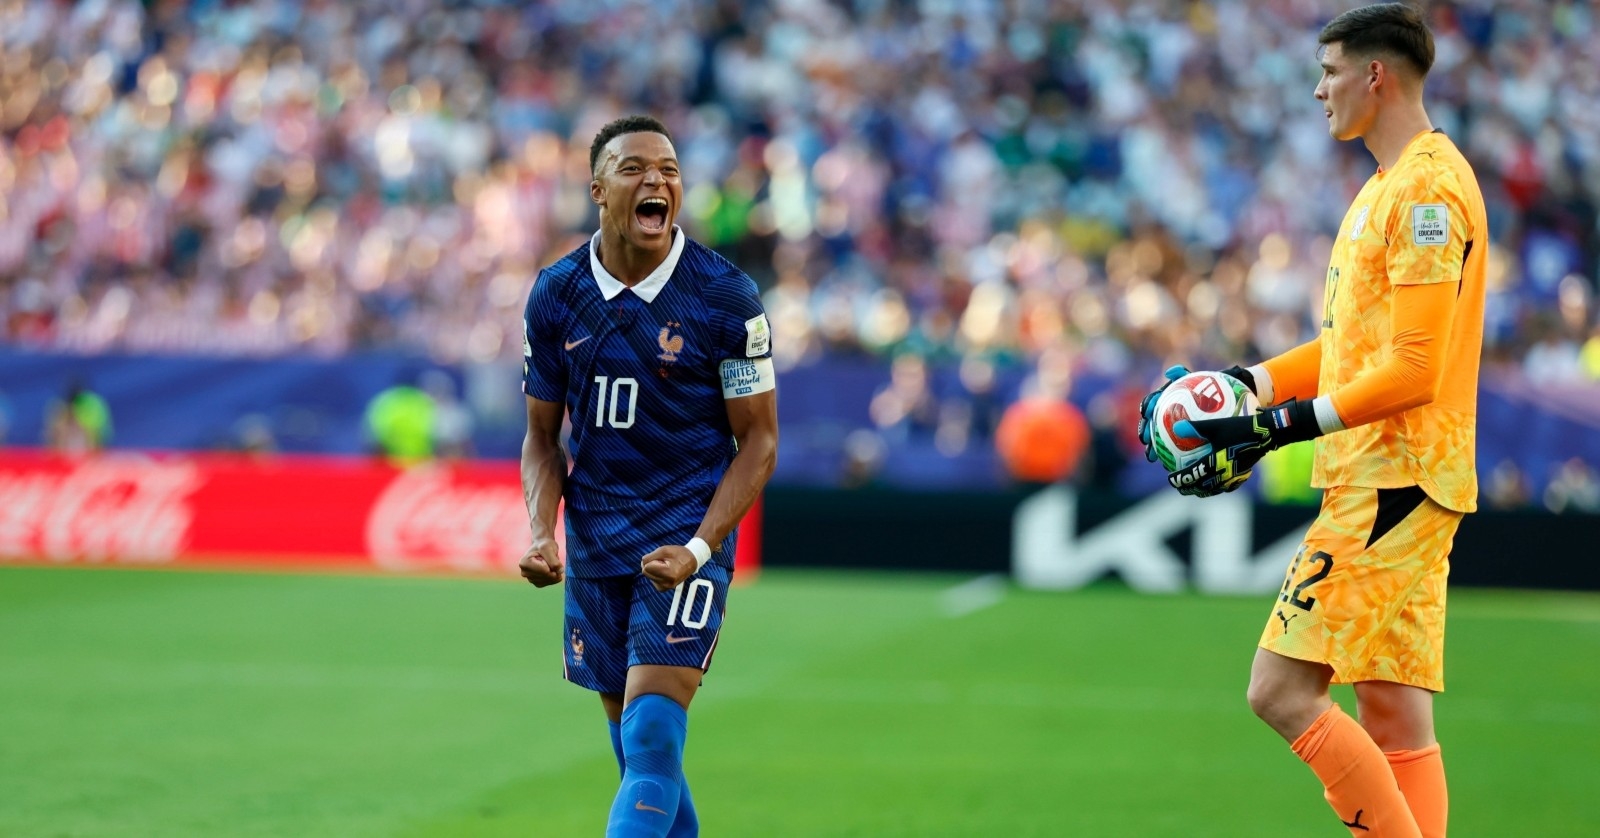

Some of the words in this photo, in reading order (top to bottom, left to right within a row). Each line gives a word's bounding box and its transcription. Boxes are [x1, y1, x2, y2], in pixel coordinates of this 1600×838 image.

[722, 358, 755, 370] FOOTBALL
[723, 365, 757, 380] UNITES
[724, 380, 737, 389] the
[738, 374, 760, 387] World
[595, 375, 639, 429] 10
[1170, 462, 1207, 488] Voit
[666, 578, 714, 630] 10
